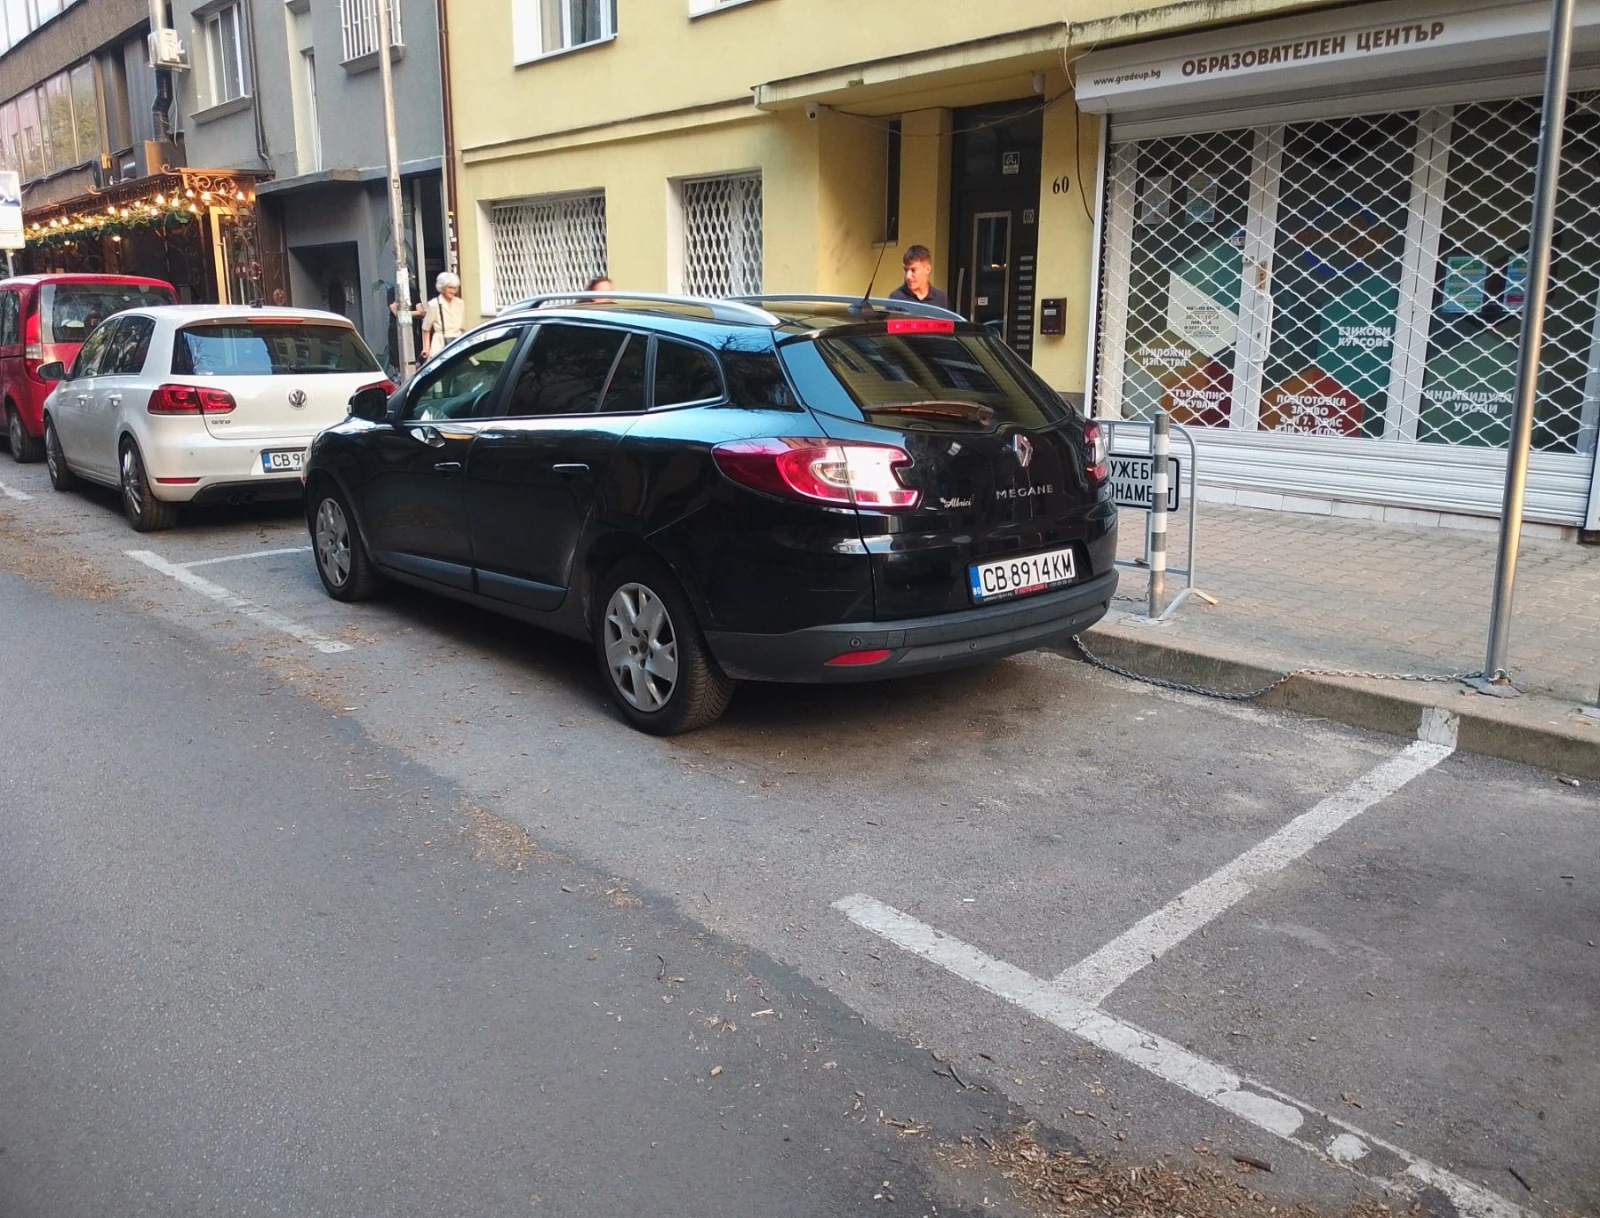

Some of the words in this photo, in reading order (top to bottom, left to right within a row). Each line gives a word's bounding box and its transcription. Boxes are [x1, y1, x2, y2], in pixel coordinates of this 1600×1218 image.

[1181, 35, 1346, 77] ОБРАЗОВАТЕЛЕН
[1356, 21, 1444, 53] ЦЕНТЪР
[1093, 69, 1161, 86] www.gradeup.bg
[1052, 176, 1069, 195] 60
[1338, 326, 1391, 336] ЕЗИКОВИ
[1338, 337, 1389, 347] КУРСОВЕ
[1276, 394, 1347, 407] ПОДГОТОВКА
[1425, 389, 1515, 403] ИНДИВИДУАЛ
[272, 454, 291, 467] CB
[1110, 460, 1153, 480] УЖЕБ
[995, 484, 1054, 500] MEGANE
[973, 587, 981, 595] BG
